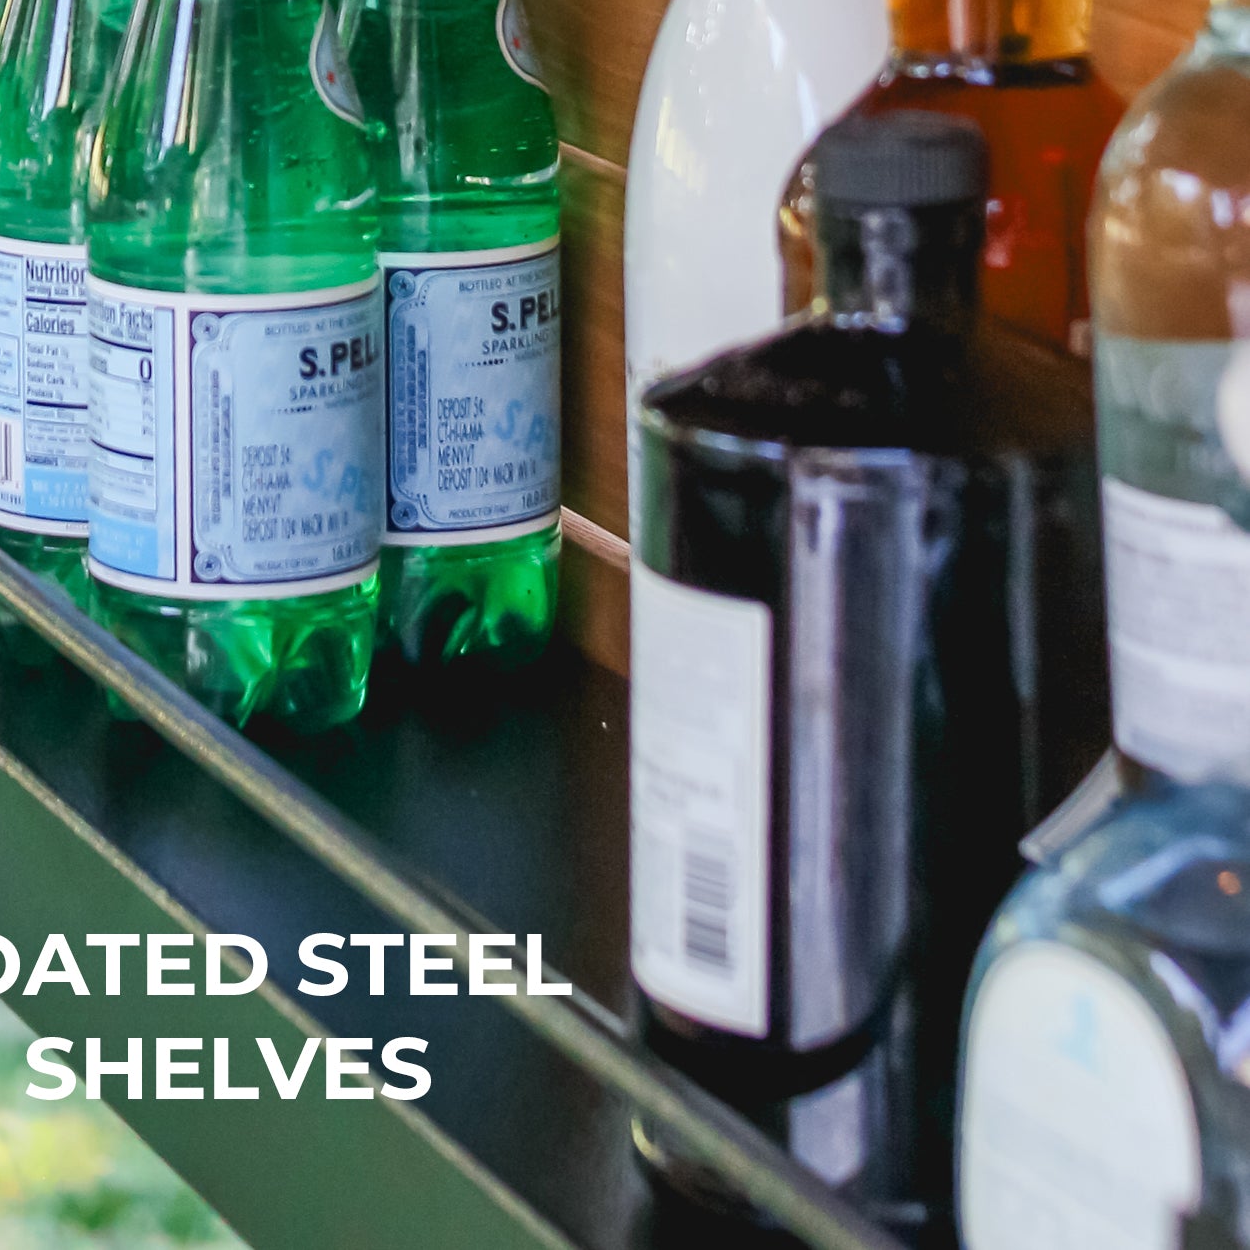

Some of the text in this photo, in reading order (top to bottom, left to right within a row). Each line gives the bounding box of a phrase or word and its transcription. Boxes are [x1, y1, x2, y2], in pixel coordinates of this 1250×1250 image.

[26, 312, 75, 335] Calories
[481, 329, 550, 355] SPARKLING
[140, 357, 152, 382] 0
[437, 396, 471, 420] DEPOSIT
[437, 467, 471, 491] DEPOSIT
